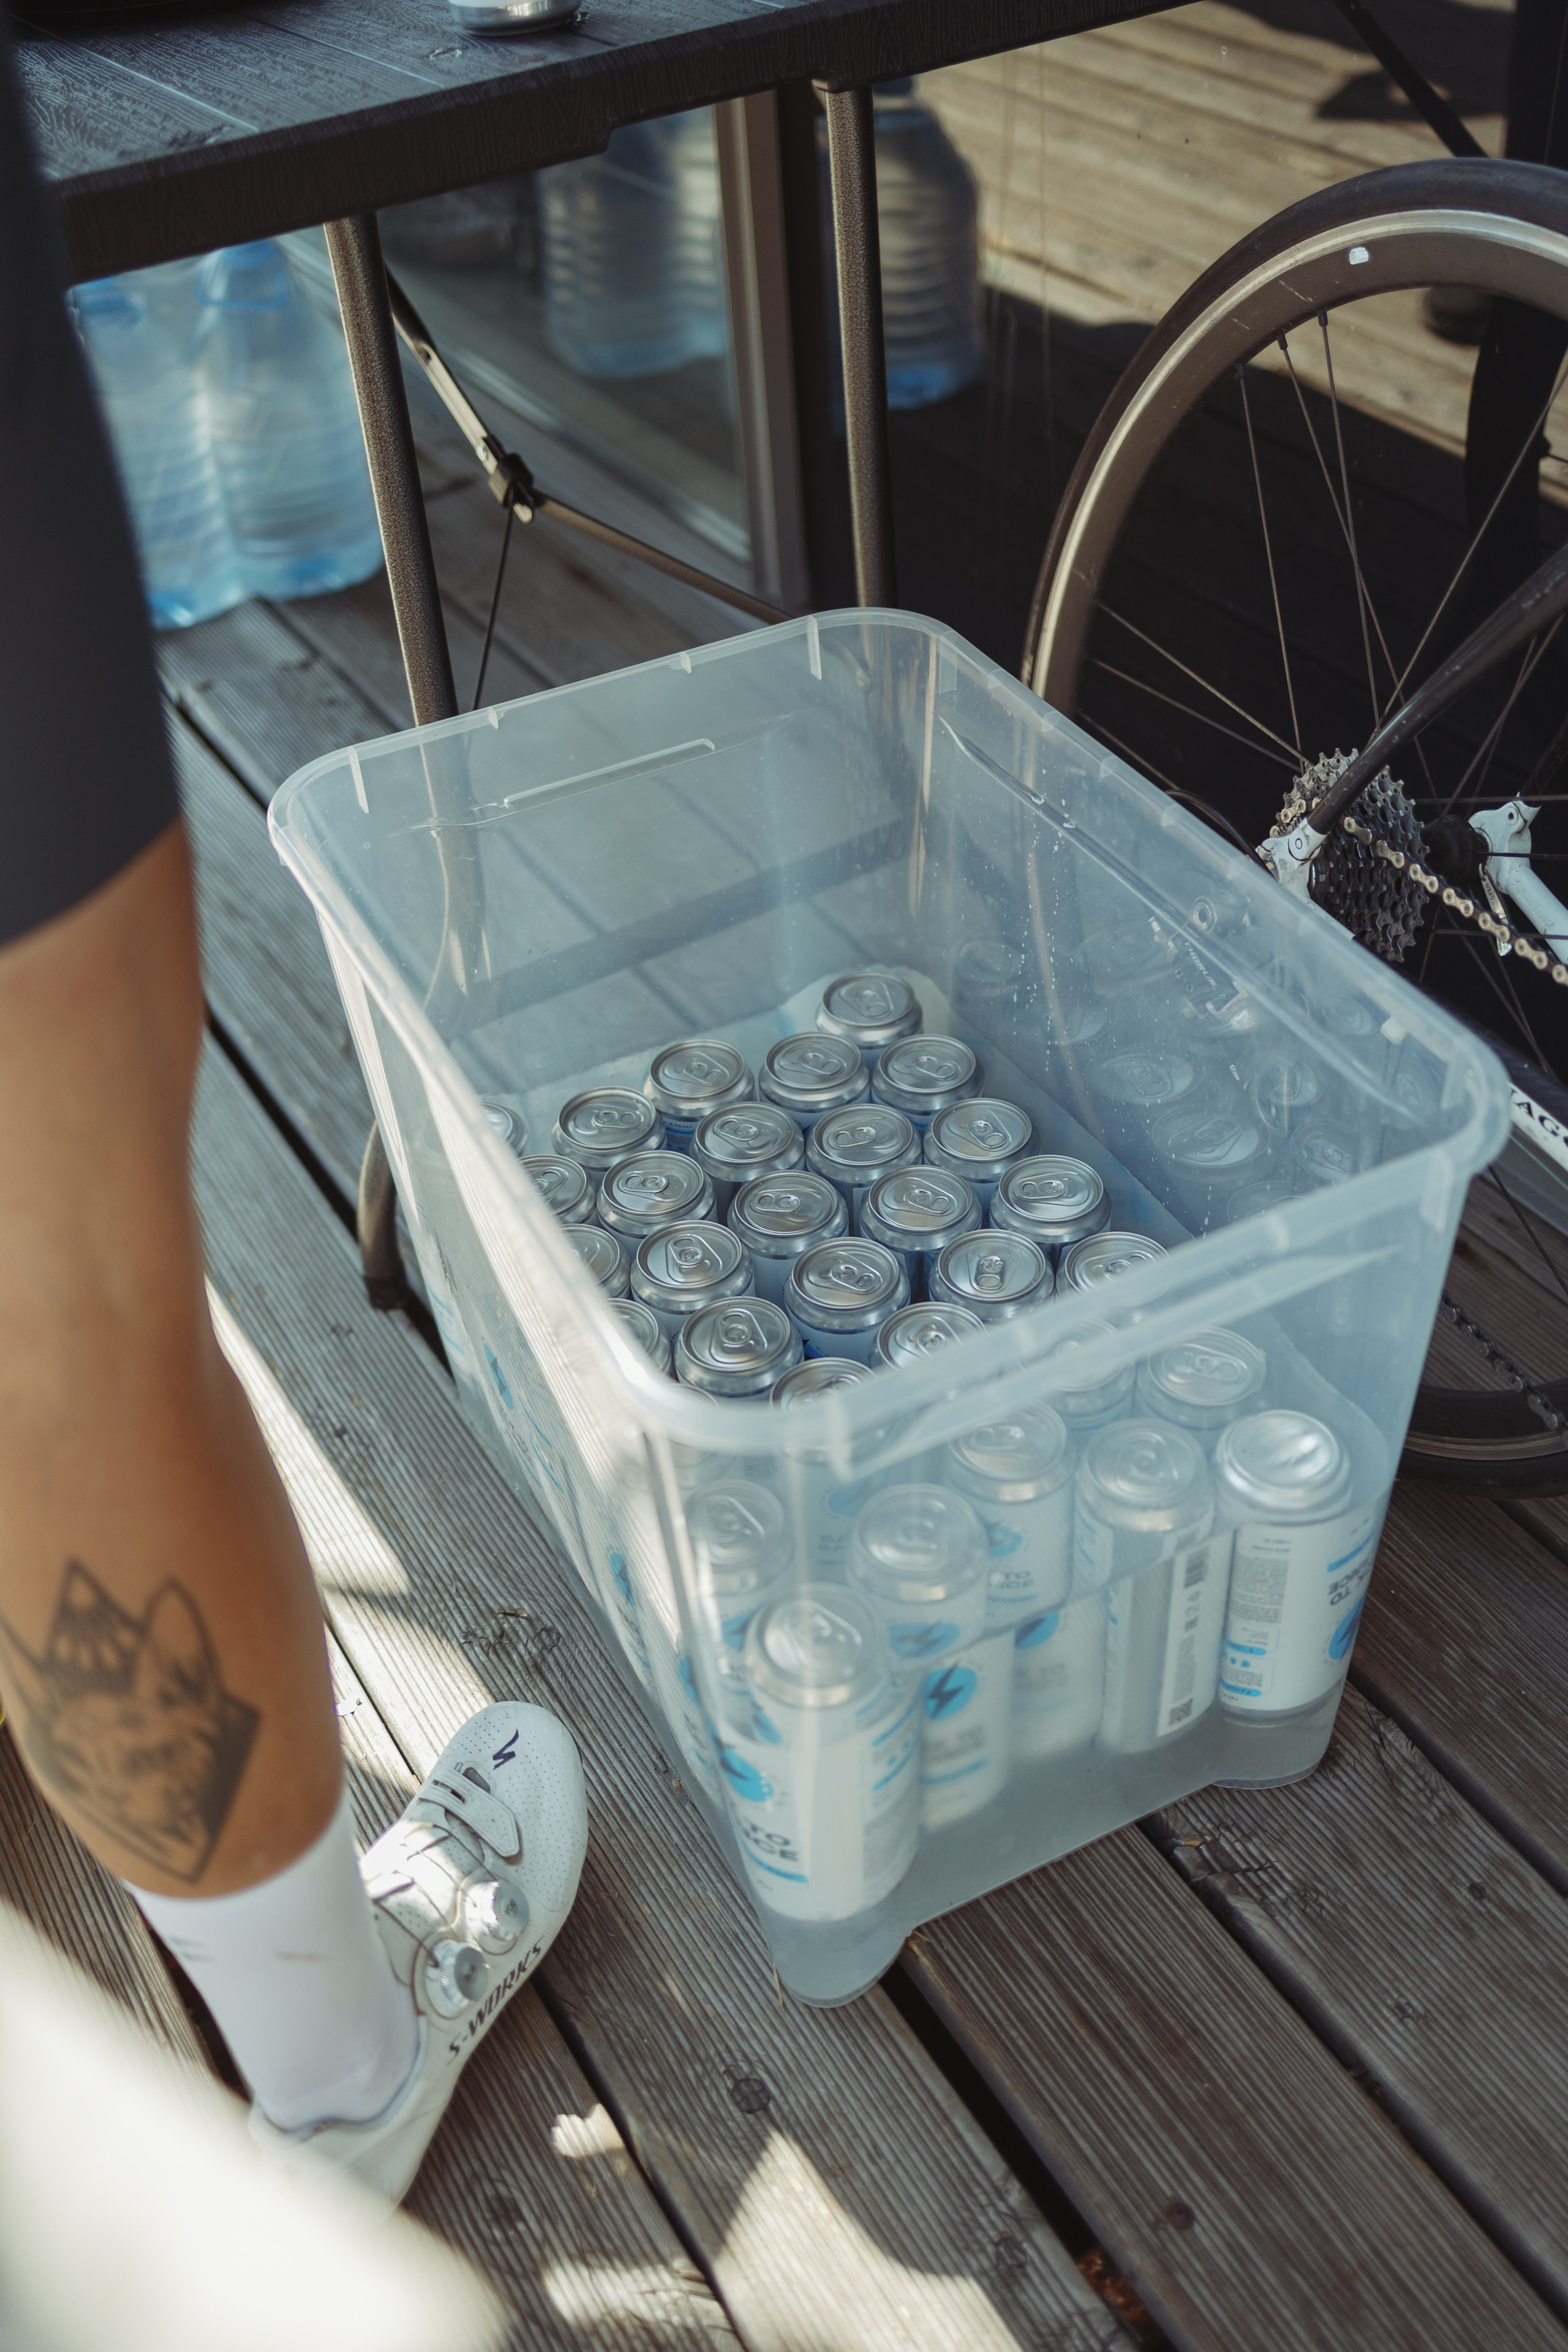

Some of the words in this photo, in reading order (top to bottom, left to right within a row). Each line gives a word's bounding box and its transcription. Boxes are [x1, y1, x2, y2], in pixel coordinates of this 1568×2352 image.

[1485, 884, 1494, 900] OPEN
[1185, 941, 1217, 986] CHORUS
[447, 1936, 544, 2067] S-WORKS
